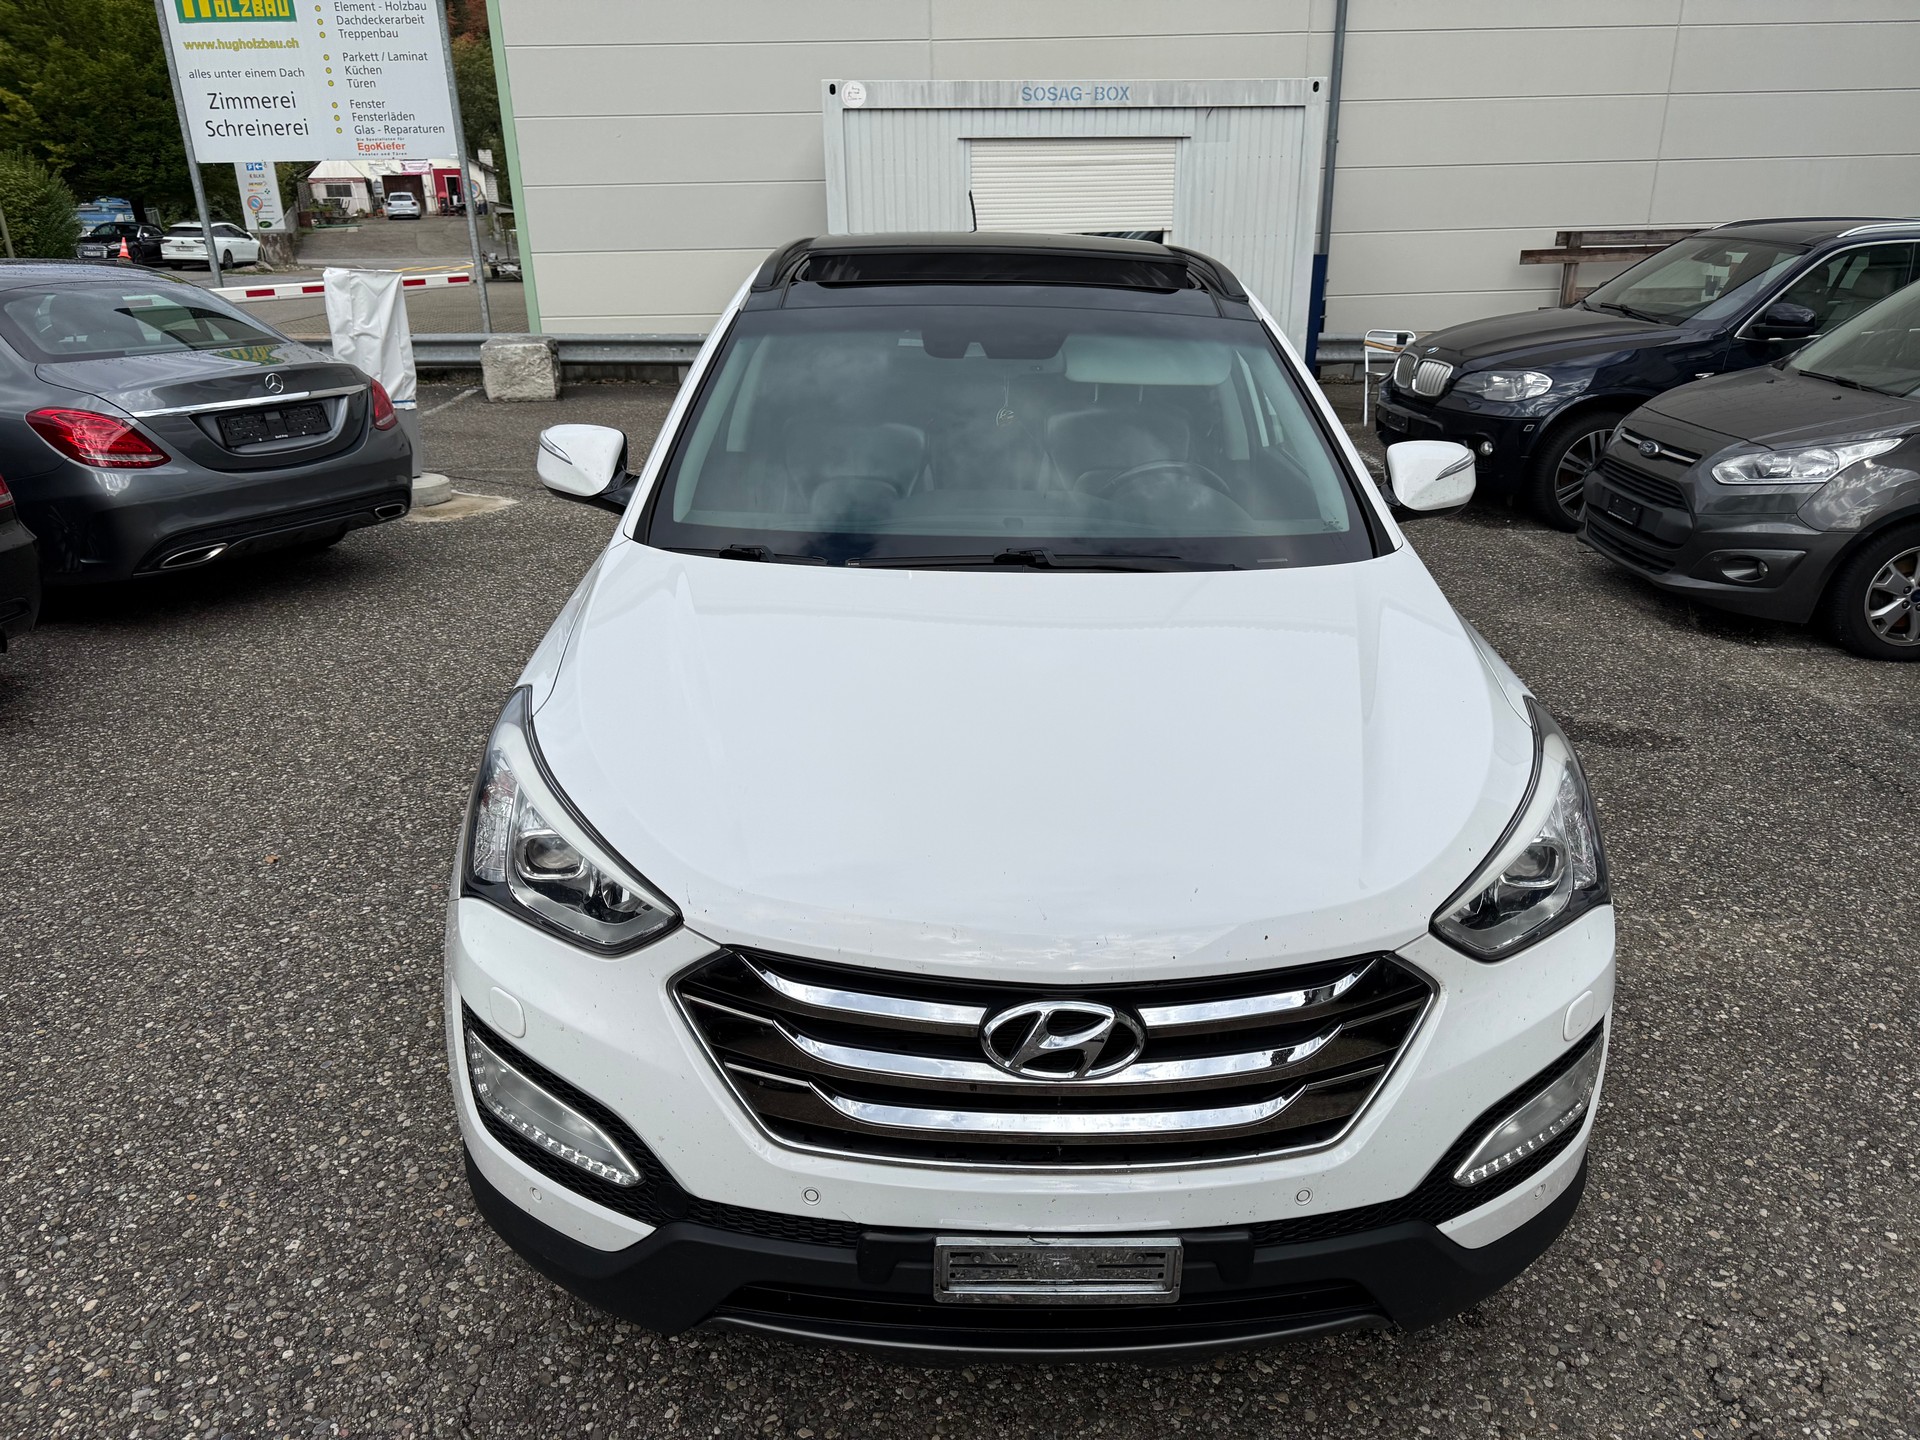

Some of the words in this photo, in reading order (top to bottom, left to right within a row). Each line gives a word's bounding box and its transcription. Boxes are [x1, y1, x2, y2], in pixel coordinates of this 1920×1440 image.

[334, 1, 376, 12] Element
[385, 1, 427, 11] Holzbau
[336, 14, 425, 26] Dachdeckerarbeit
[338, 28, 399, 40] Treppenbau
[183, 38, 300, 51] www.hugholzbau.ch
[342, 52, 380, 62] Parkett
[387, 51, 428, 62] Laminat
[188, 69, 212, 79] alles
[214, 69, 242, 79] unter
[244, 68, 277, 78] einem
[279, 67, 305, 78] Dach
[344, 65, 382, 75] Küchen
[347, 78, 376, 88] Türen
[206, 90, 297, 110] Zimmerei
[349, 99, 386, 109] Fenster
[351, 111, 416, 122] Fensterläden
[205, 118, 309, 138] Schreinerei
[353, 124, 376, 135] Glas
[383, 124, 445, 137] Reparaturen
[357, 142, 406, 153] EgoKiefer
